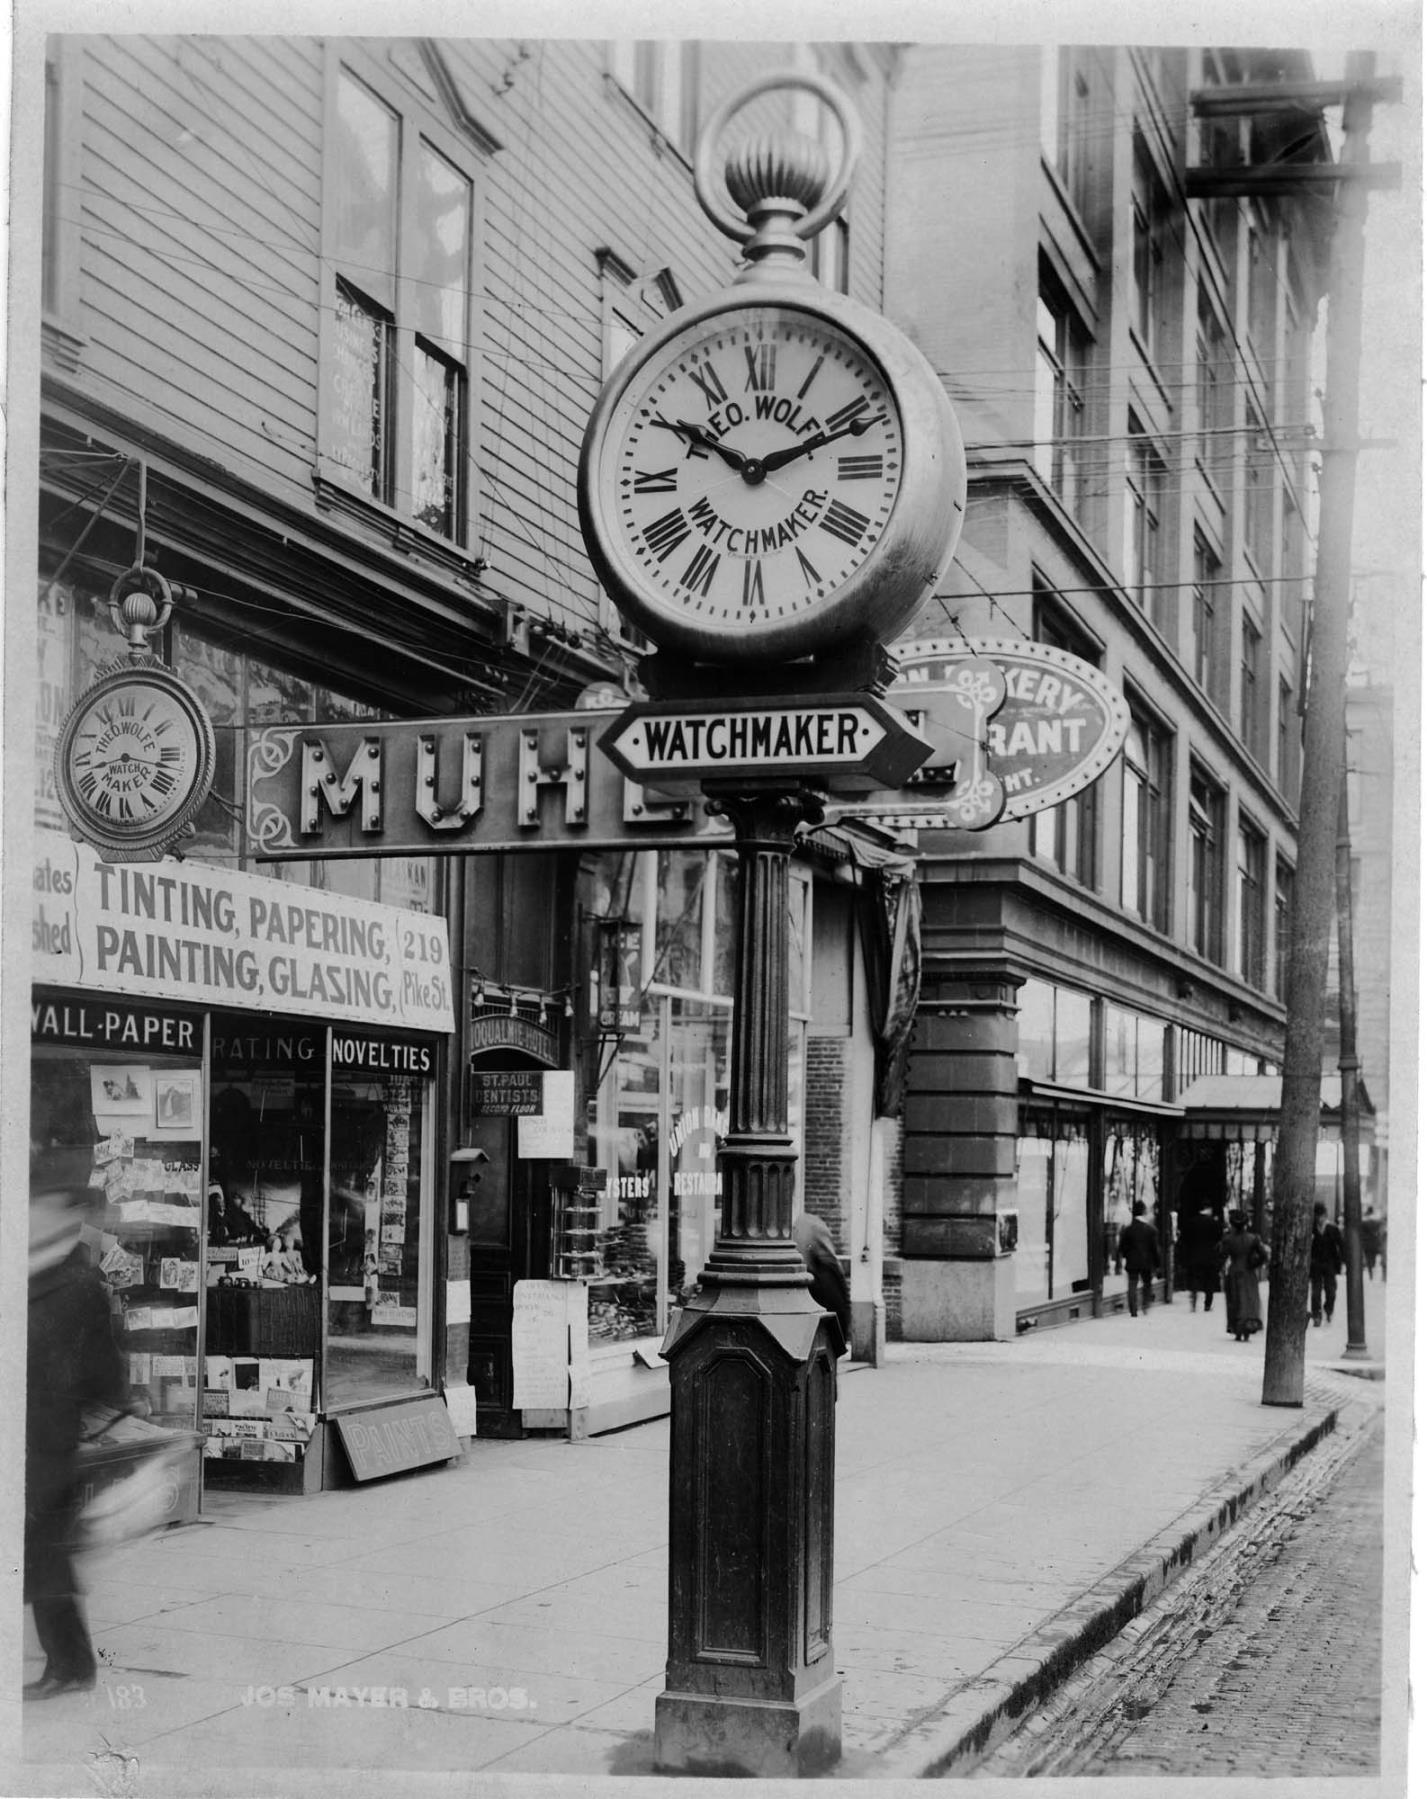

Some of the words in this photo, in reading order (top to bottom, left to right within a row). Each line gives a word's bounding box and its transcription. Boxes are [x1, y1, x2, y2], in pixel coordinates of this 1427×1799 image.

[687, 489, 829, 554] WATCHMAKER.
[1000, 665, 1086, 715] KERY
[643, 713, 859, 761] WATCHMAKER
[987, 718, 1087, 757] RANT
[101, 765, 152, 793] MAKER
[108, 763, 141, 776] WATCH
[94, 862, 240, 939] TINTING,
[250, 896, 391, 965] PAPERING,
[96, 925, 265, 996] PAINTING,
[403, 930, 443, 965] 219
[212, 1036, 316, 1060] RATING
[332, 1038, 430, 1072] NOVELTIES
[475, 1088, 538, 1103] DENTISTS
[603, 1176, 650, 1198] YSTERS
[347, 1411, 451, 1471] PAINTS
